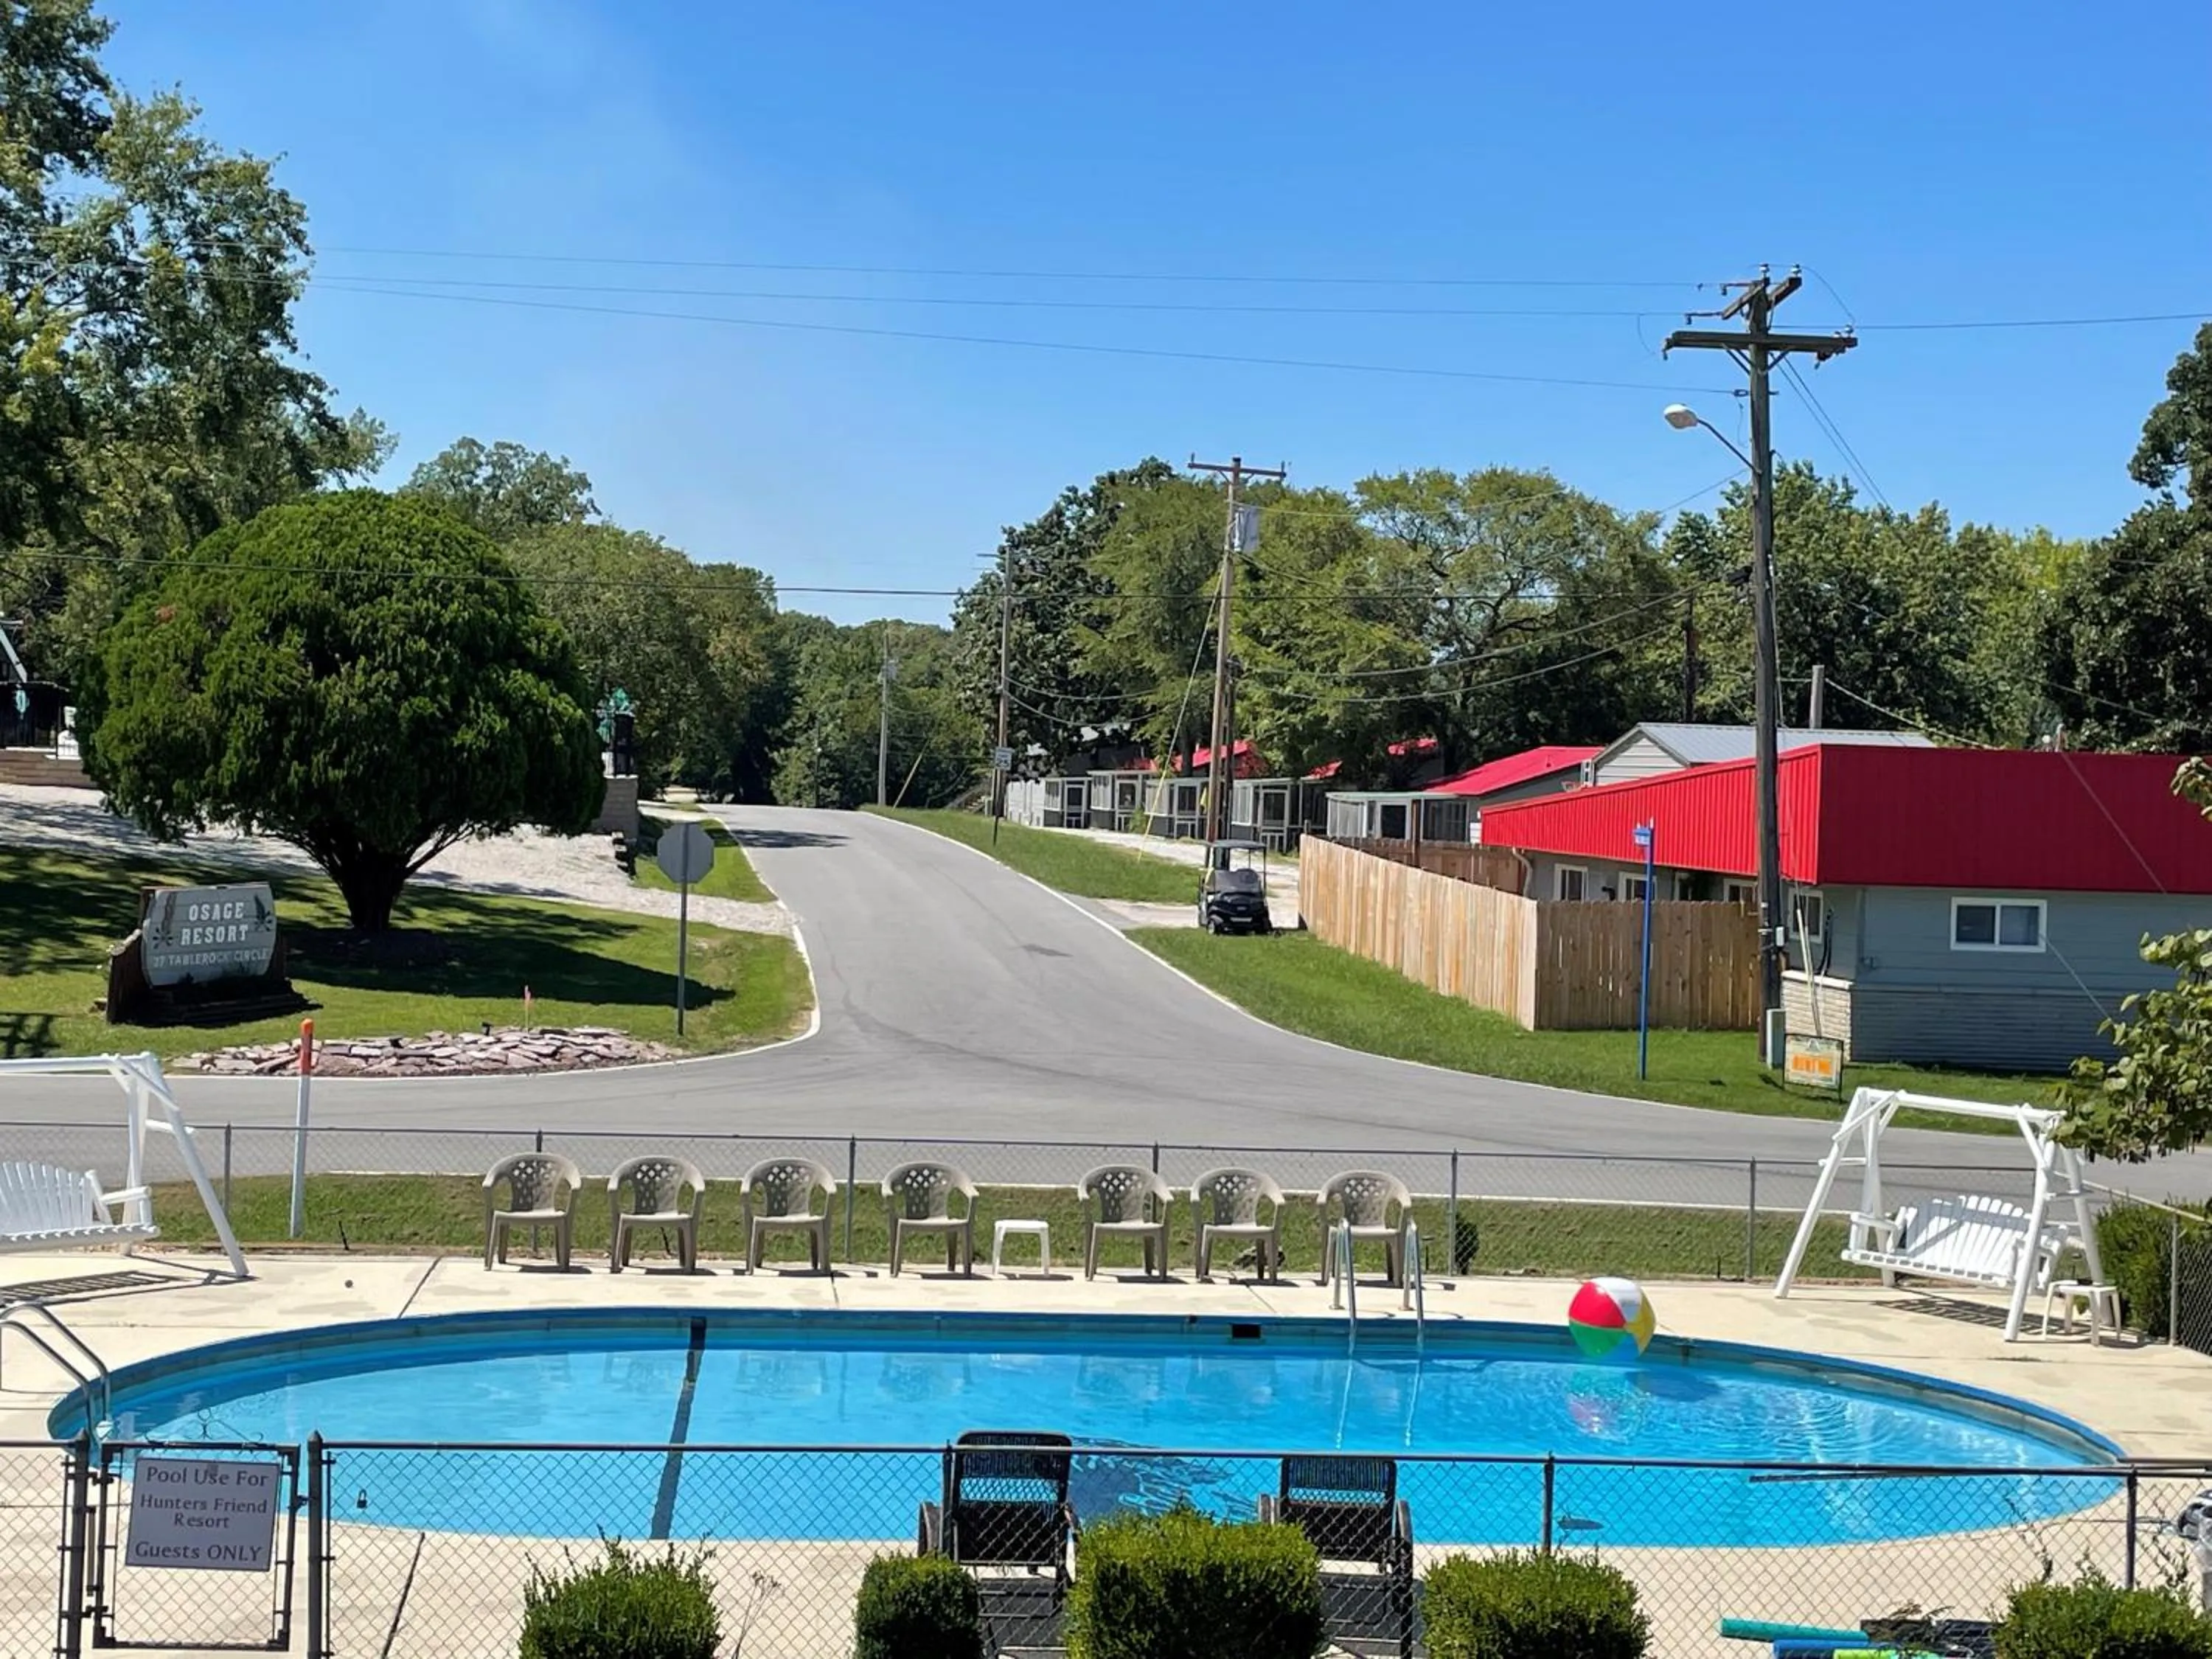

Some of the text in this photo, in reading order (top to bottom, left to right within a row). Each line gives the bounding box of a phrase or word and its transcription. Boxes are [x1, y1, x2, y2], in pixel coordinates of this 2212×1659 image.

[189, 902, 244, 922] OSAGE
[181, 925, 248, 945] RESORT
[147, 1467, 268, 1487] Pool Use For
[140, 1494, 267, 1514] Hunters Friend
[174, 1514, 229, 1528] Resort
[135, 1541, 262, 1562] Guests ONLY
